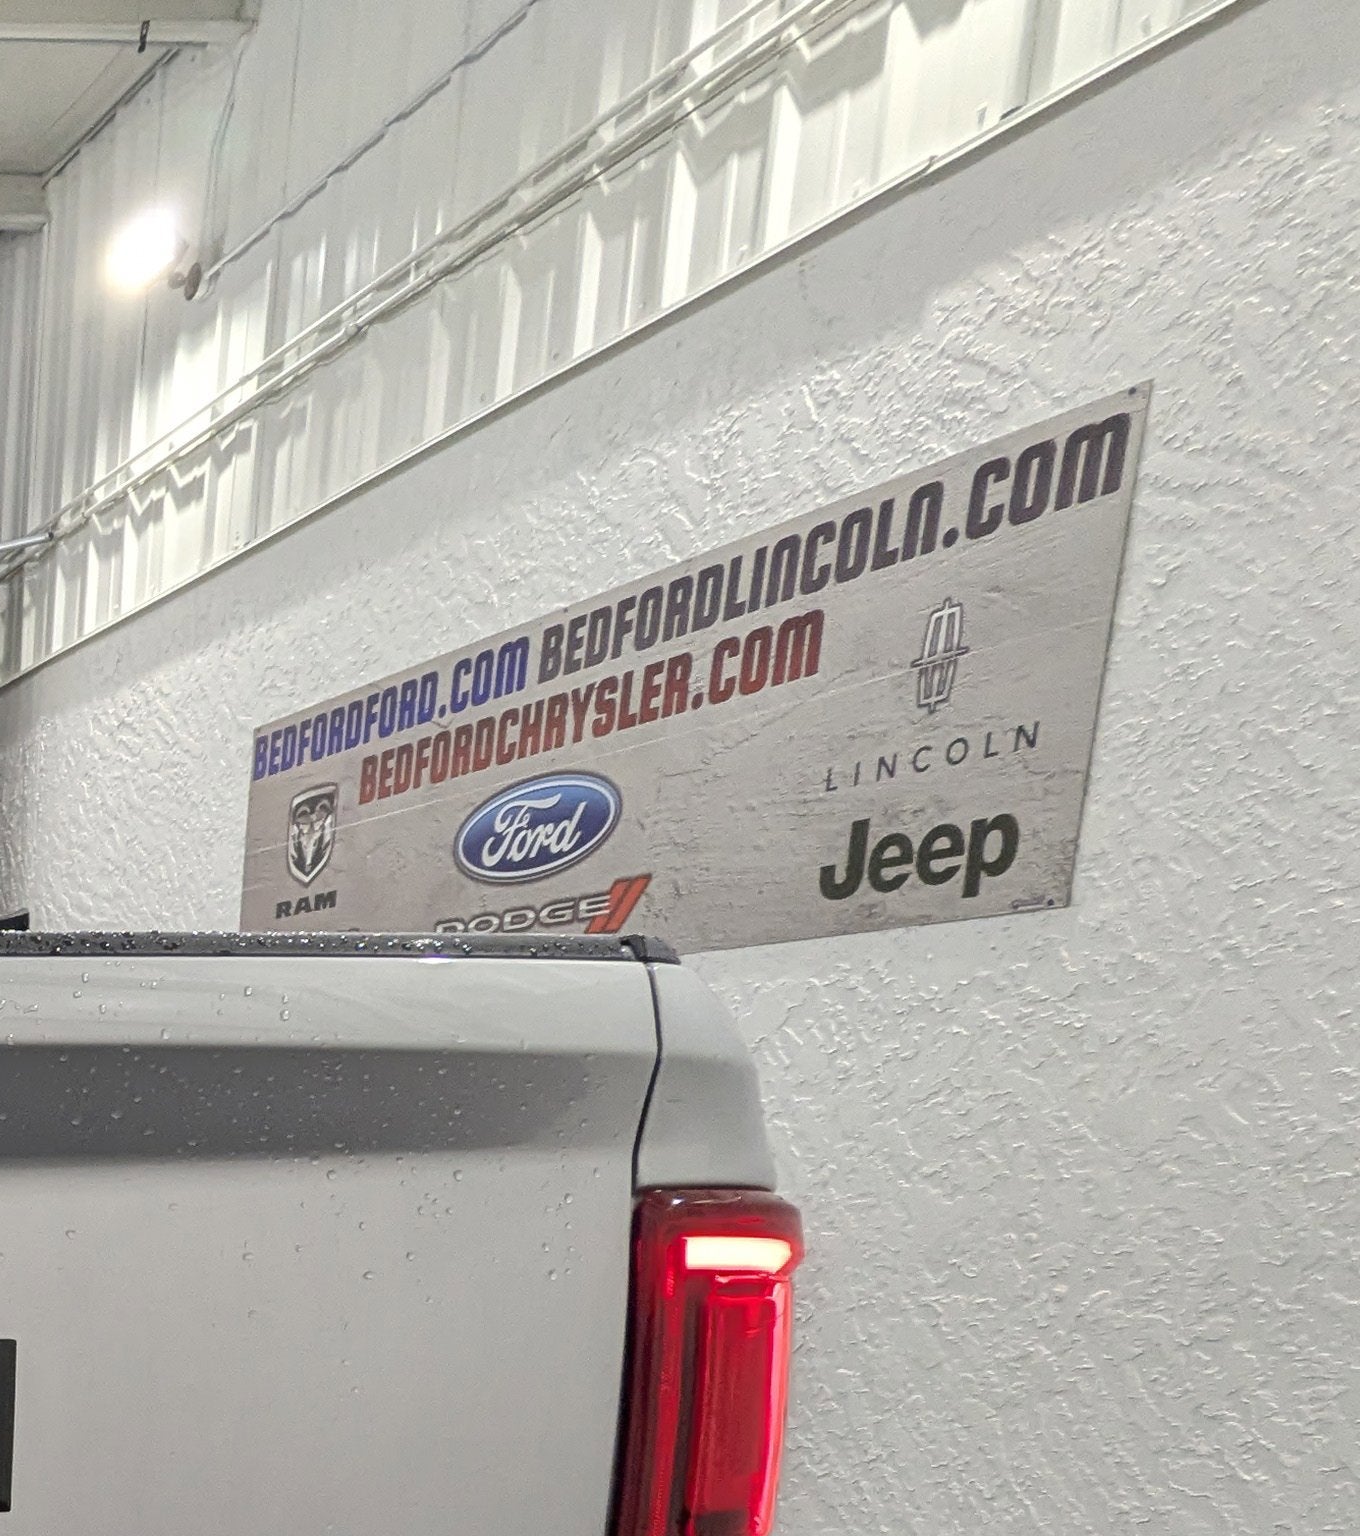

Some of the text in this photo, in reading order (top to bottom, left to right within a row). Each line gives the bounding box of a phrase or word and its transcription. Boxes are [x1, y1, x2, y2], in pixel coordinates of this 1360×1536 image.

[252, 412, 1130, 782] BEDFORDFORD.COM BEDFORDLINCOLN.COM
[358, 609, 825, 805] BEDFORDCHRYSLER.COM
[823, 721, 1041, 793] LINCOLN
[481, 793, 587, 867] Ford
[819, 812, 1020, 901] Jeep
[275, 890, 337, 920] RAM
